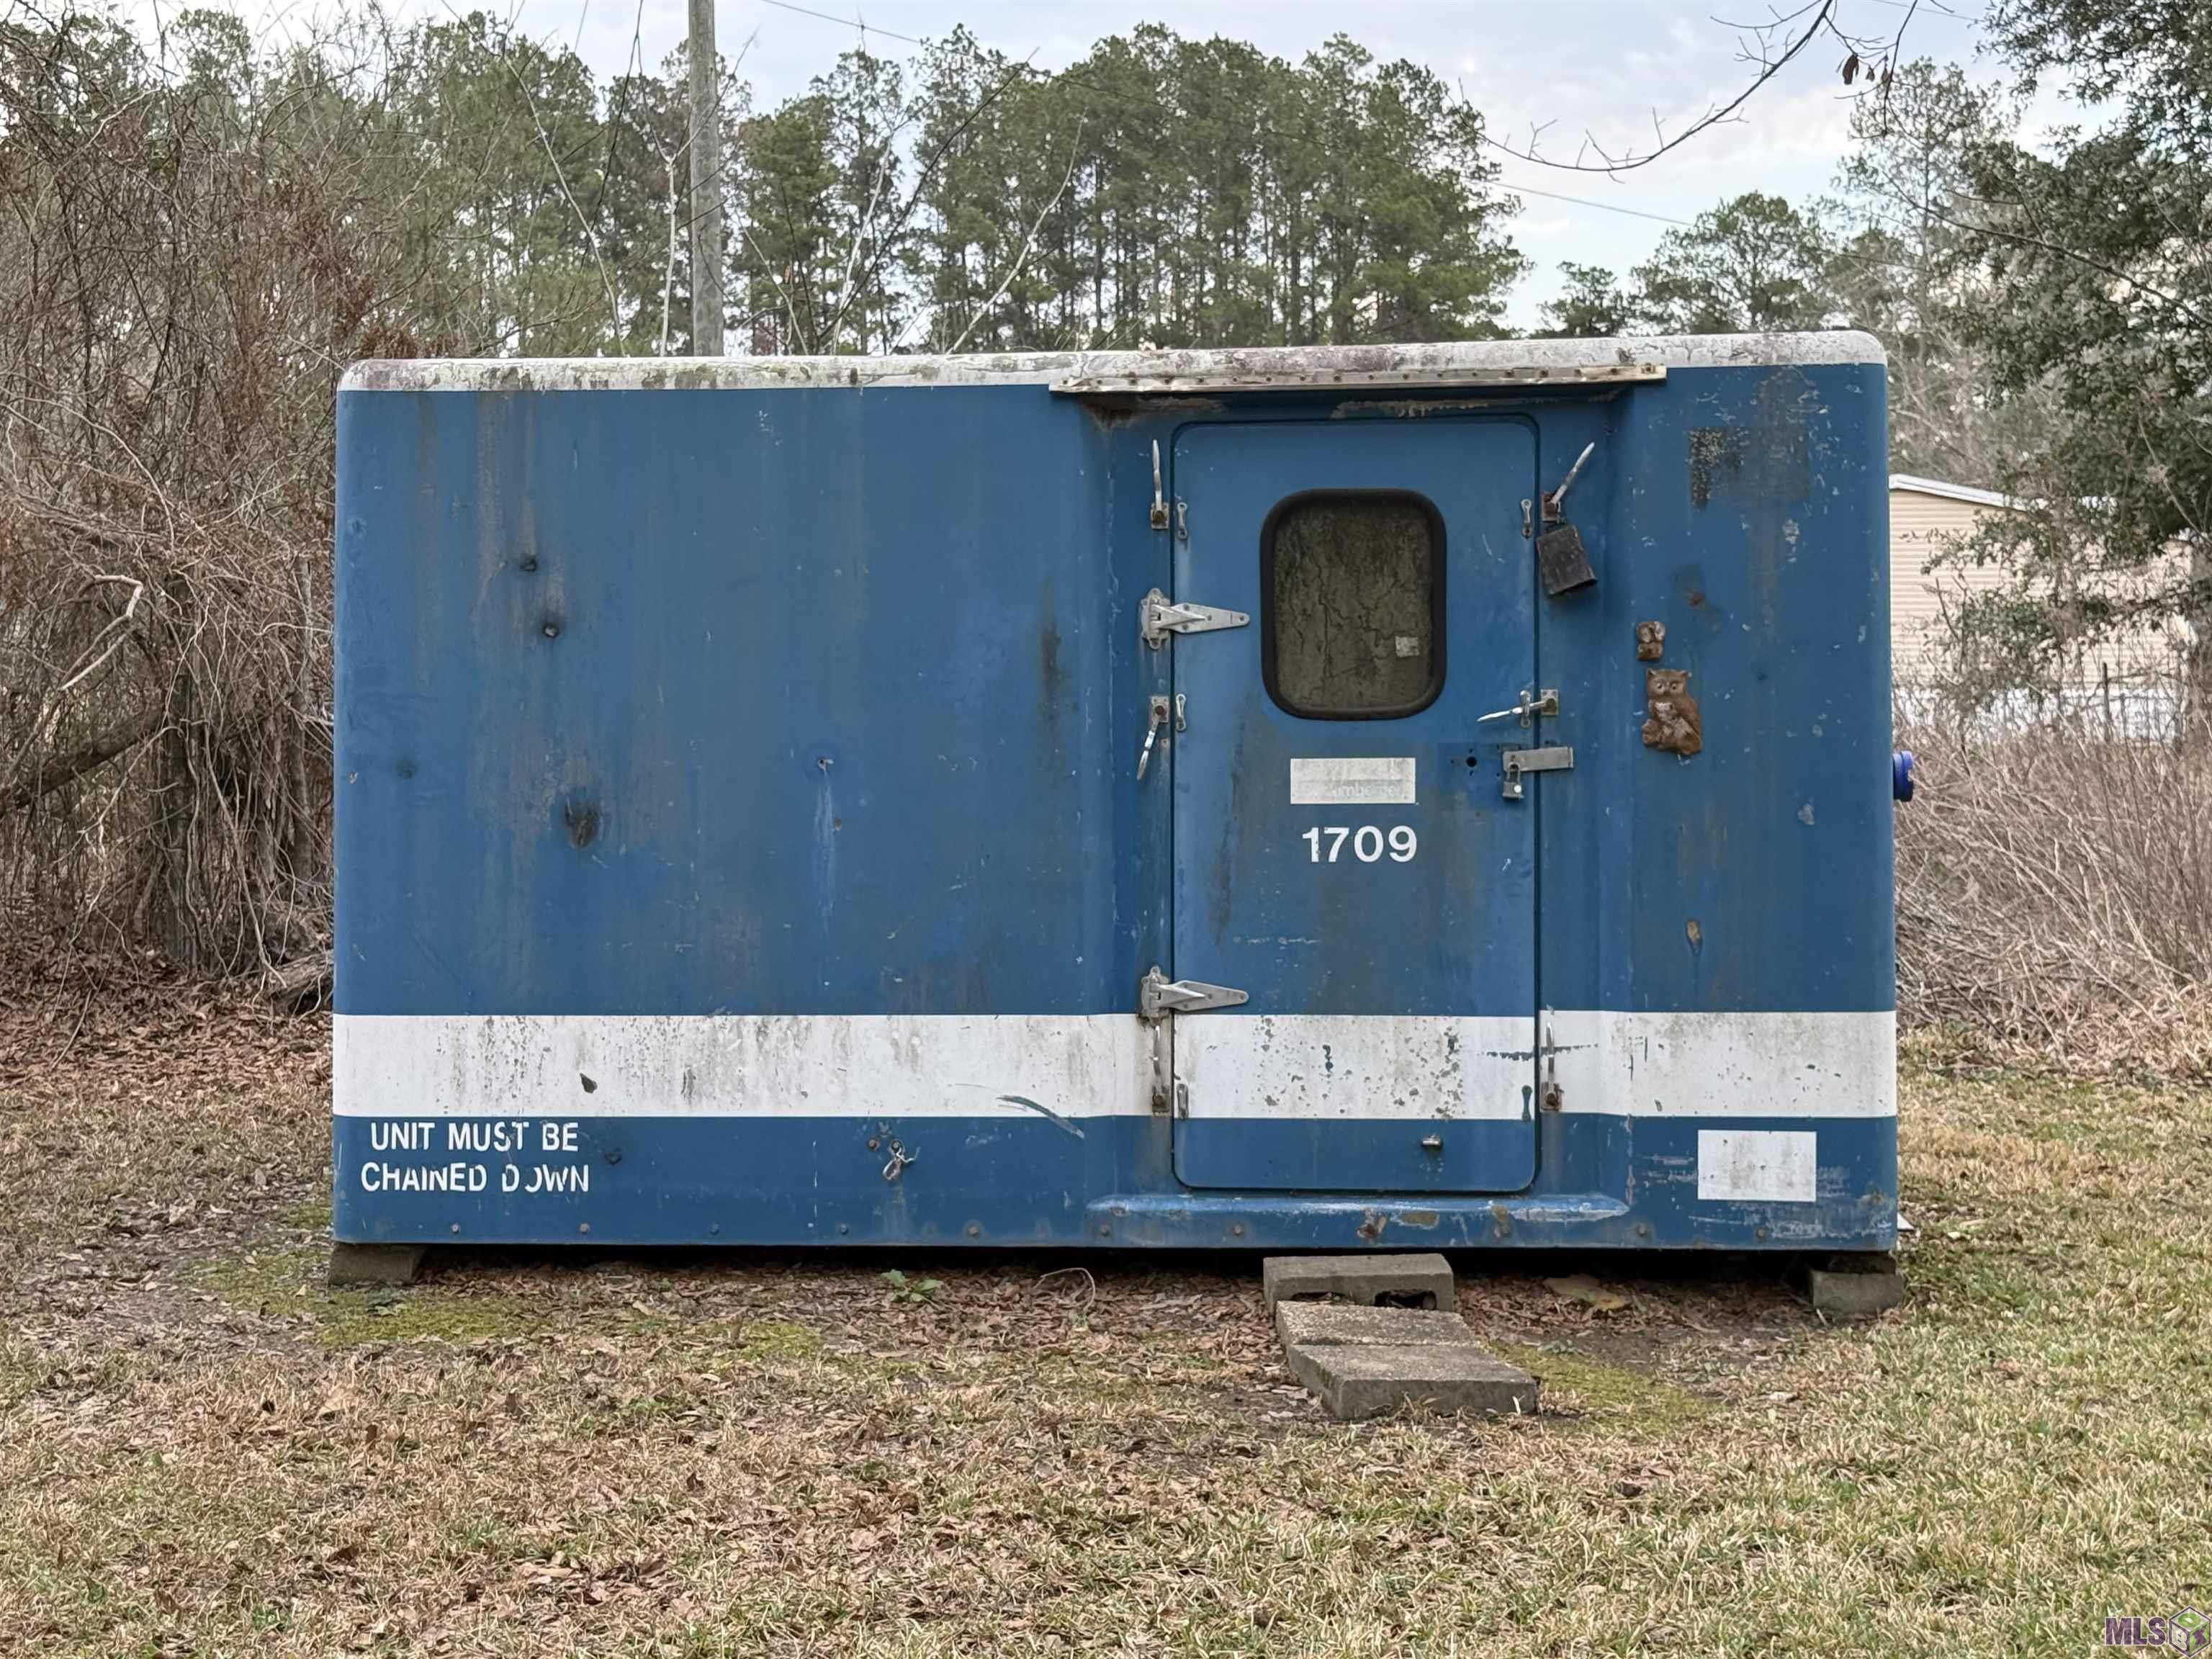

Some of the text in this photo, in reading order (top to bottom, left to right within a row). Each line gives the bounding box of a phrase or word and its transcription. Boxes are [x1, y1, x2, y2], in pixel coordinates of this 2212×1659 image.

[1302, 824, 1418, 863] 1709
[370, 1121, 579, 1152] UNIT MUST BE
[360, 1161, 487, 1192] CHAINED
